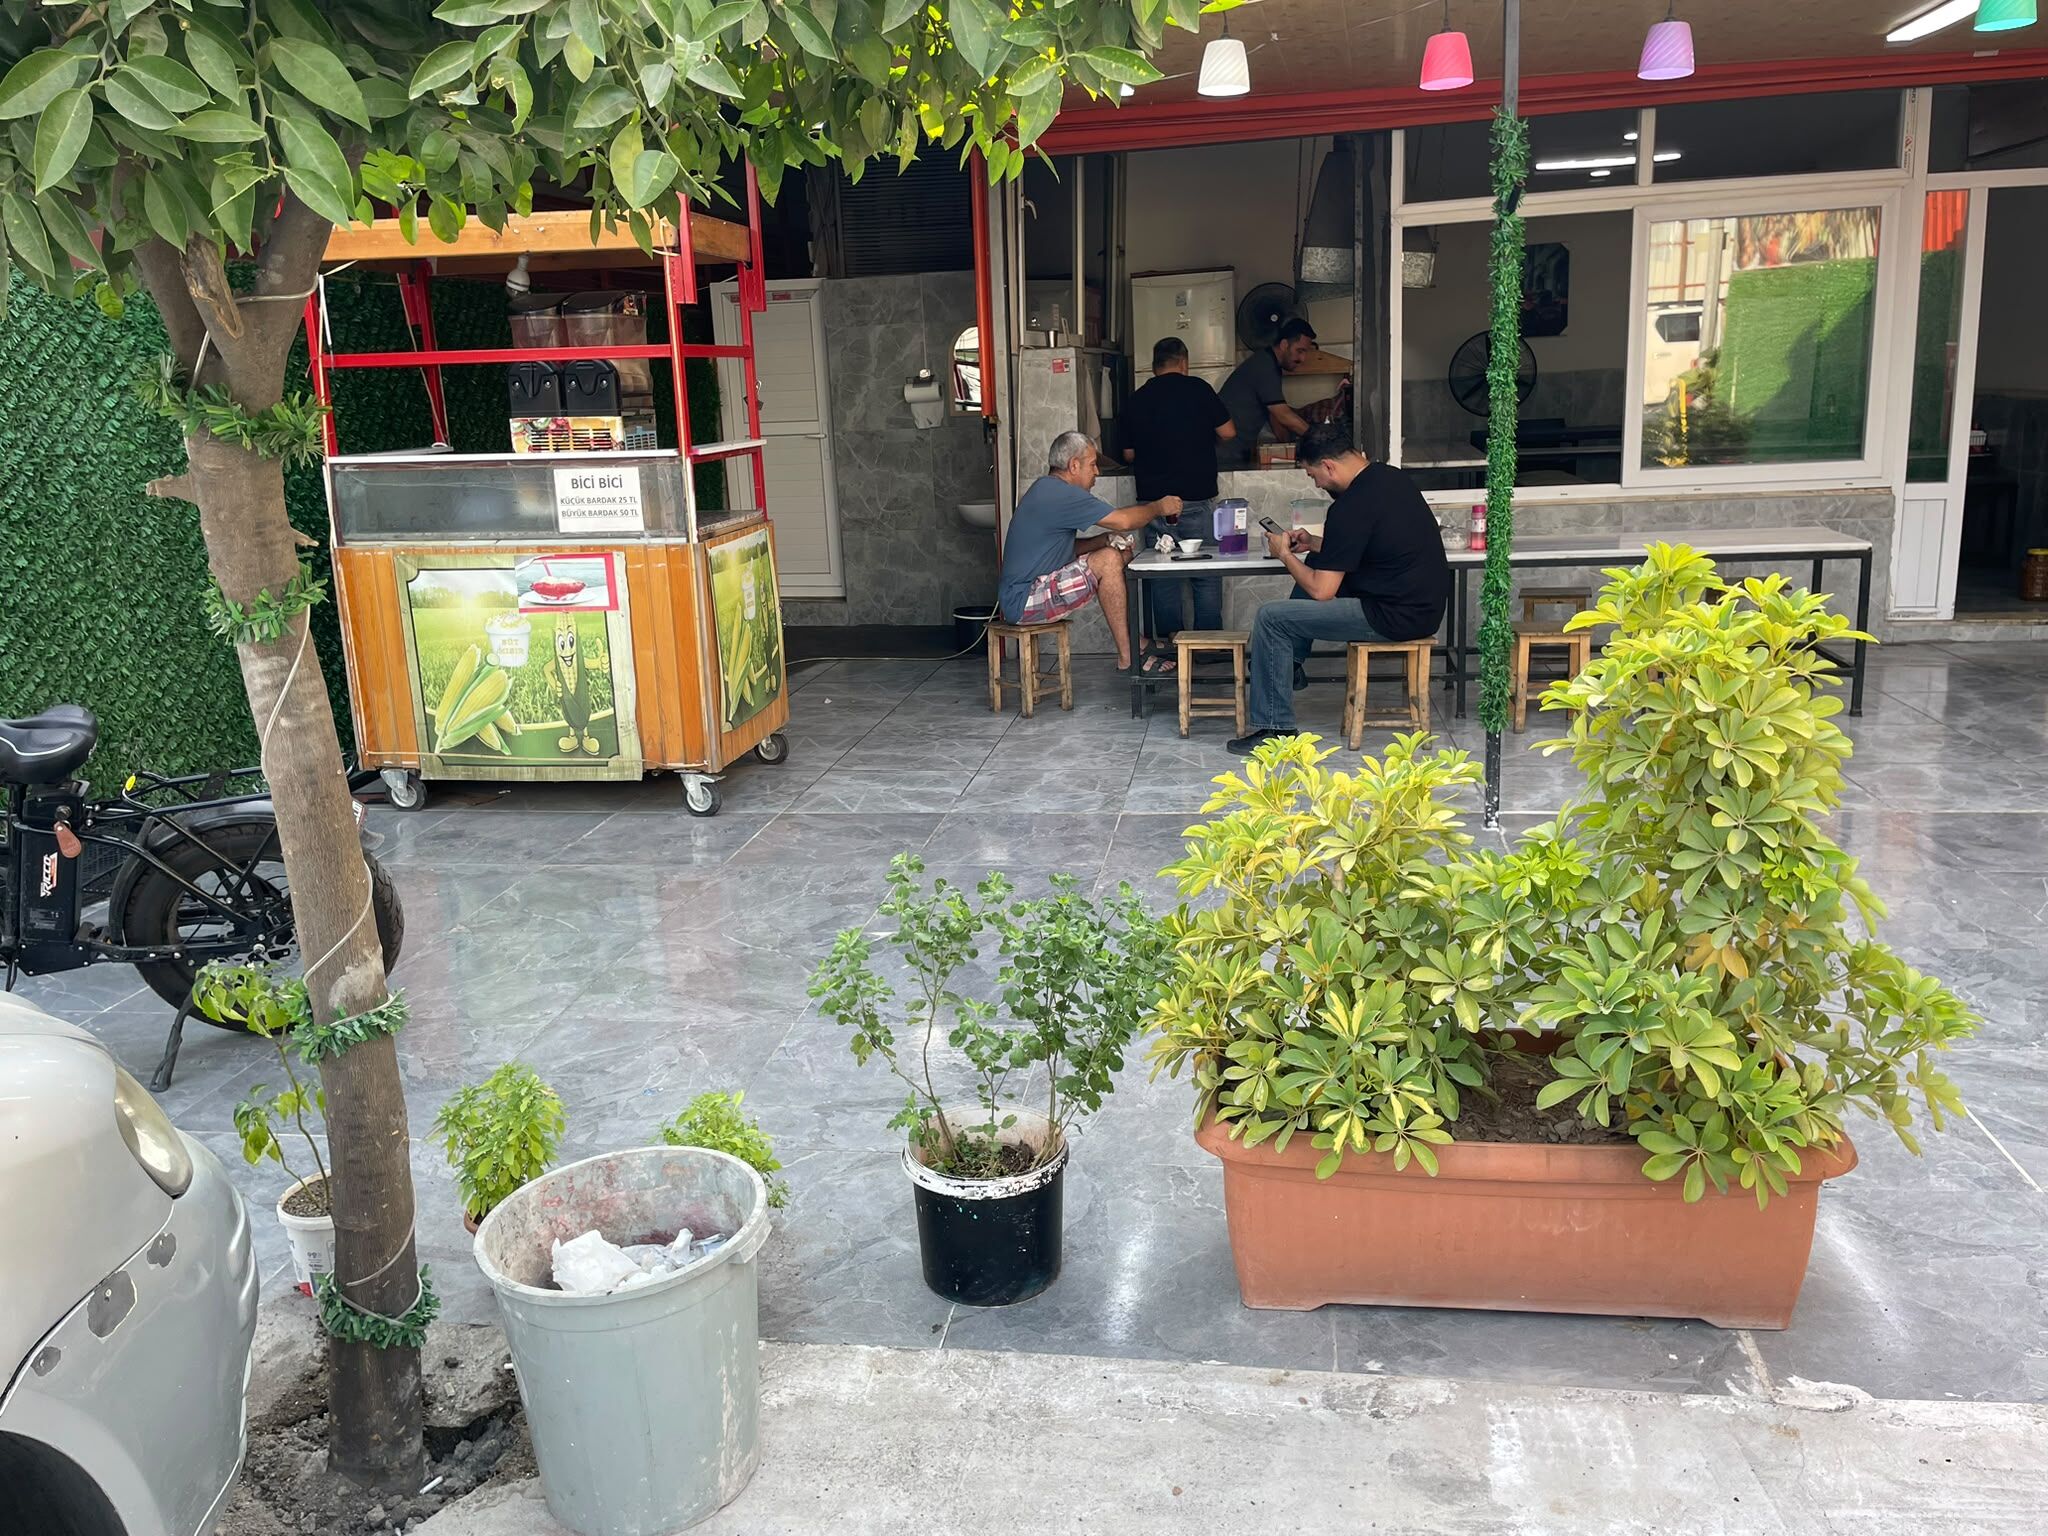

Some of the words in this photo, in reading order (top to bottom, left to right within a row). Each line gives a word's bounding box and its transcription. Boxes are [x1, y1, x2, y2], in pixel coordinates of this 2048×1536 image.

[571, 474, 595, 489] BİCİ
[599, 474, 623, 488] BİCİ
[560, 496, 585, 505] KÜÇÜK
[586, 496, 617, 504] BARDAK
[561, 509, 587, 517] BÜYÜK
[40, 854, 52, 897] RICCO
